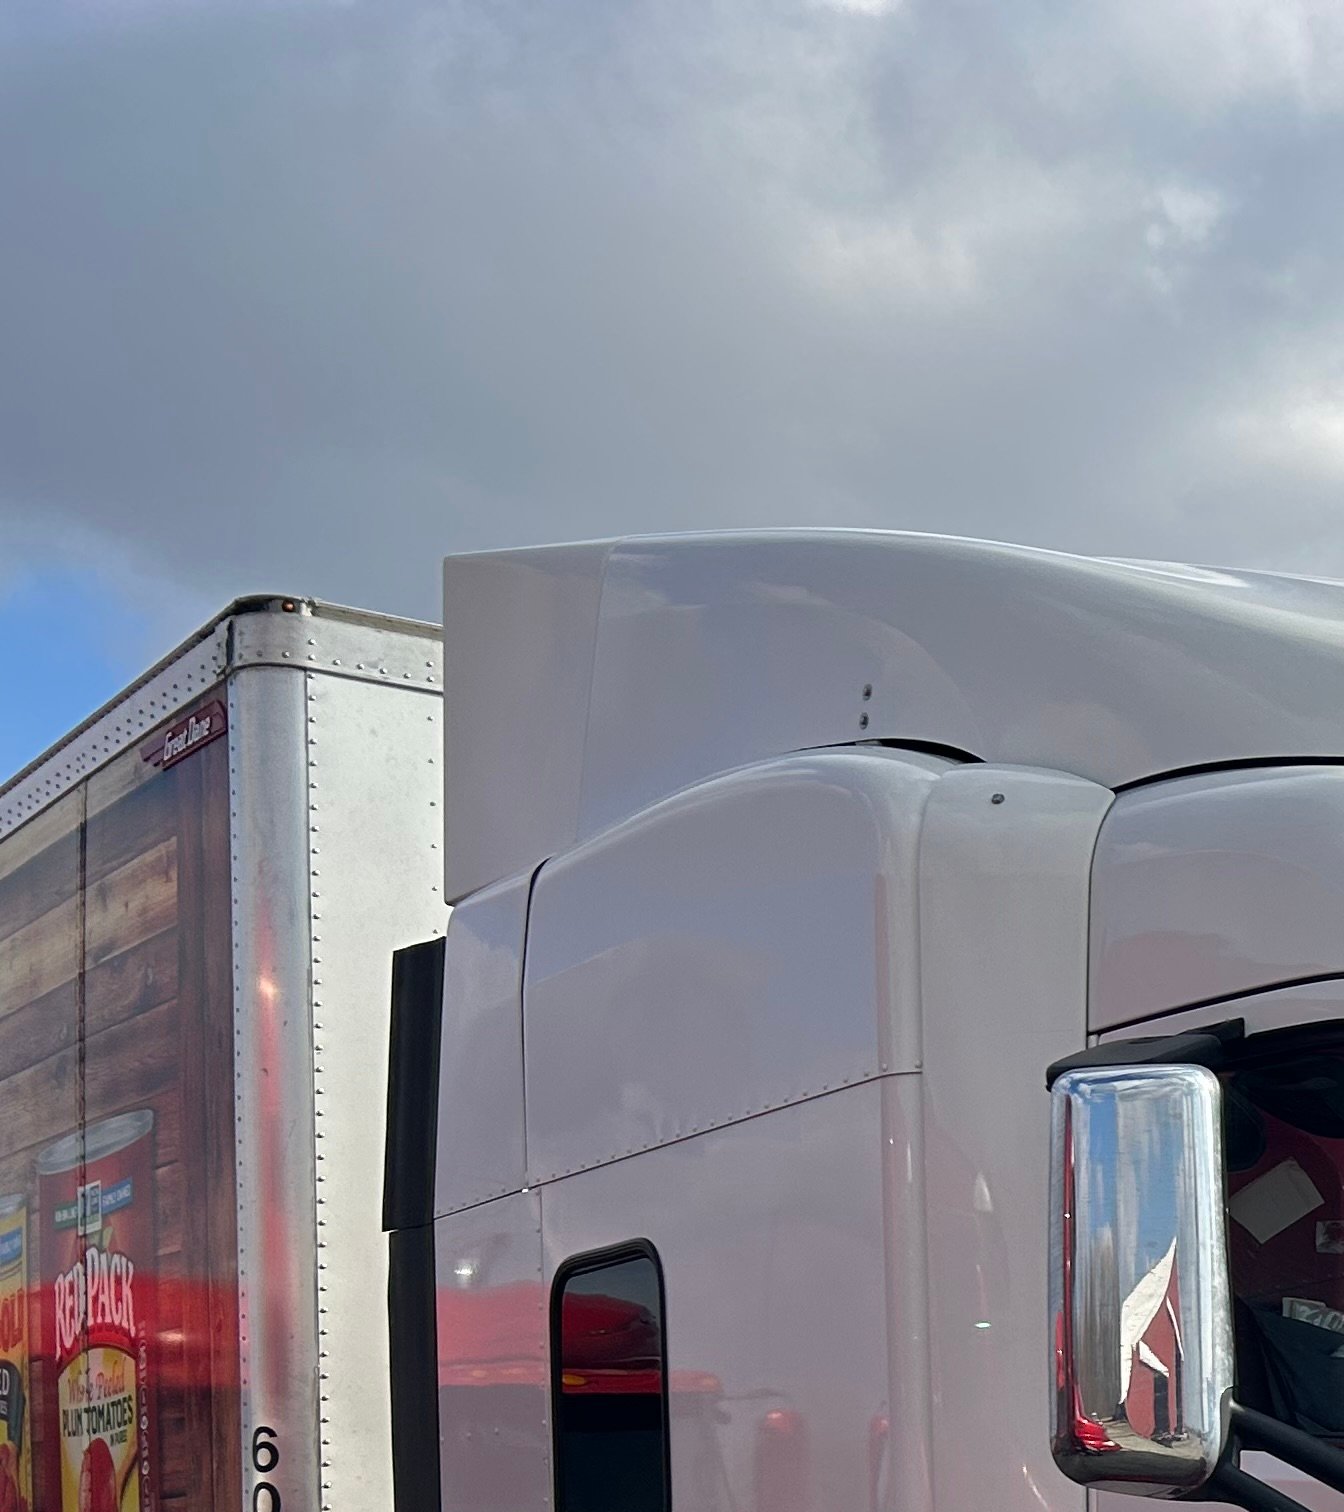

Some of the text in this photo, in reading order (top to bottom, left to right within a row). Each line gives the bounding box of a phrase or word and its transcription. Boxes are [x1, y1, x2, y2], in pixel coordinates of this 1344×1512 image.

[163, 715, 211, 761] Great Dane
[83, 1394, 133, 1436] TOMATOES
